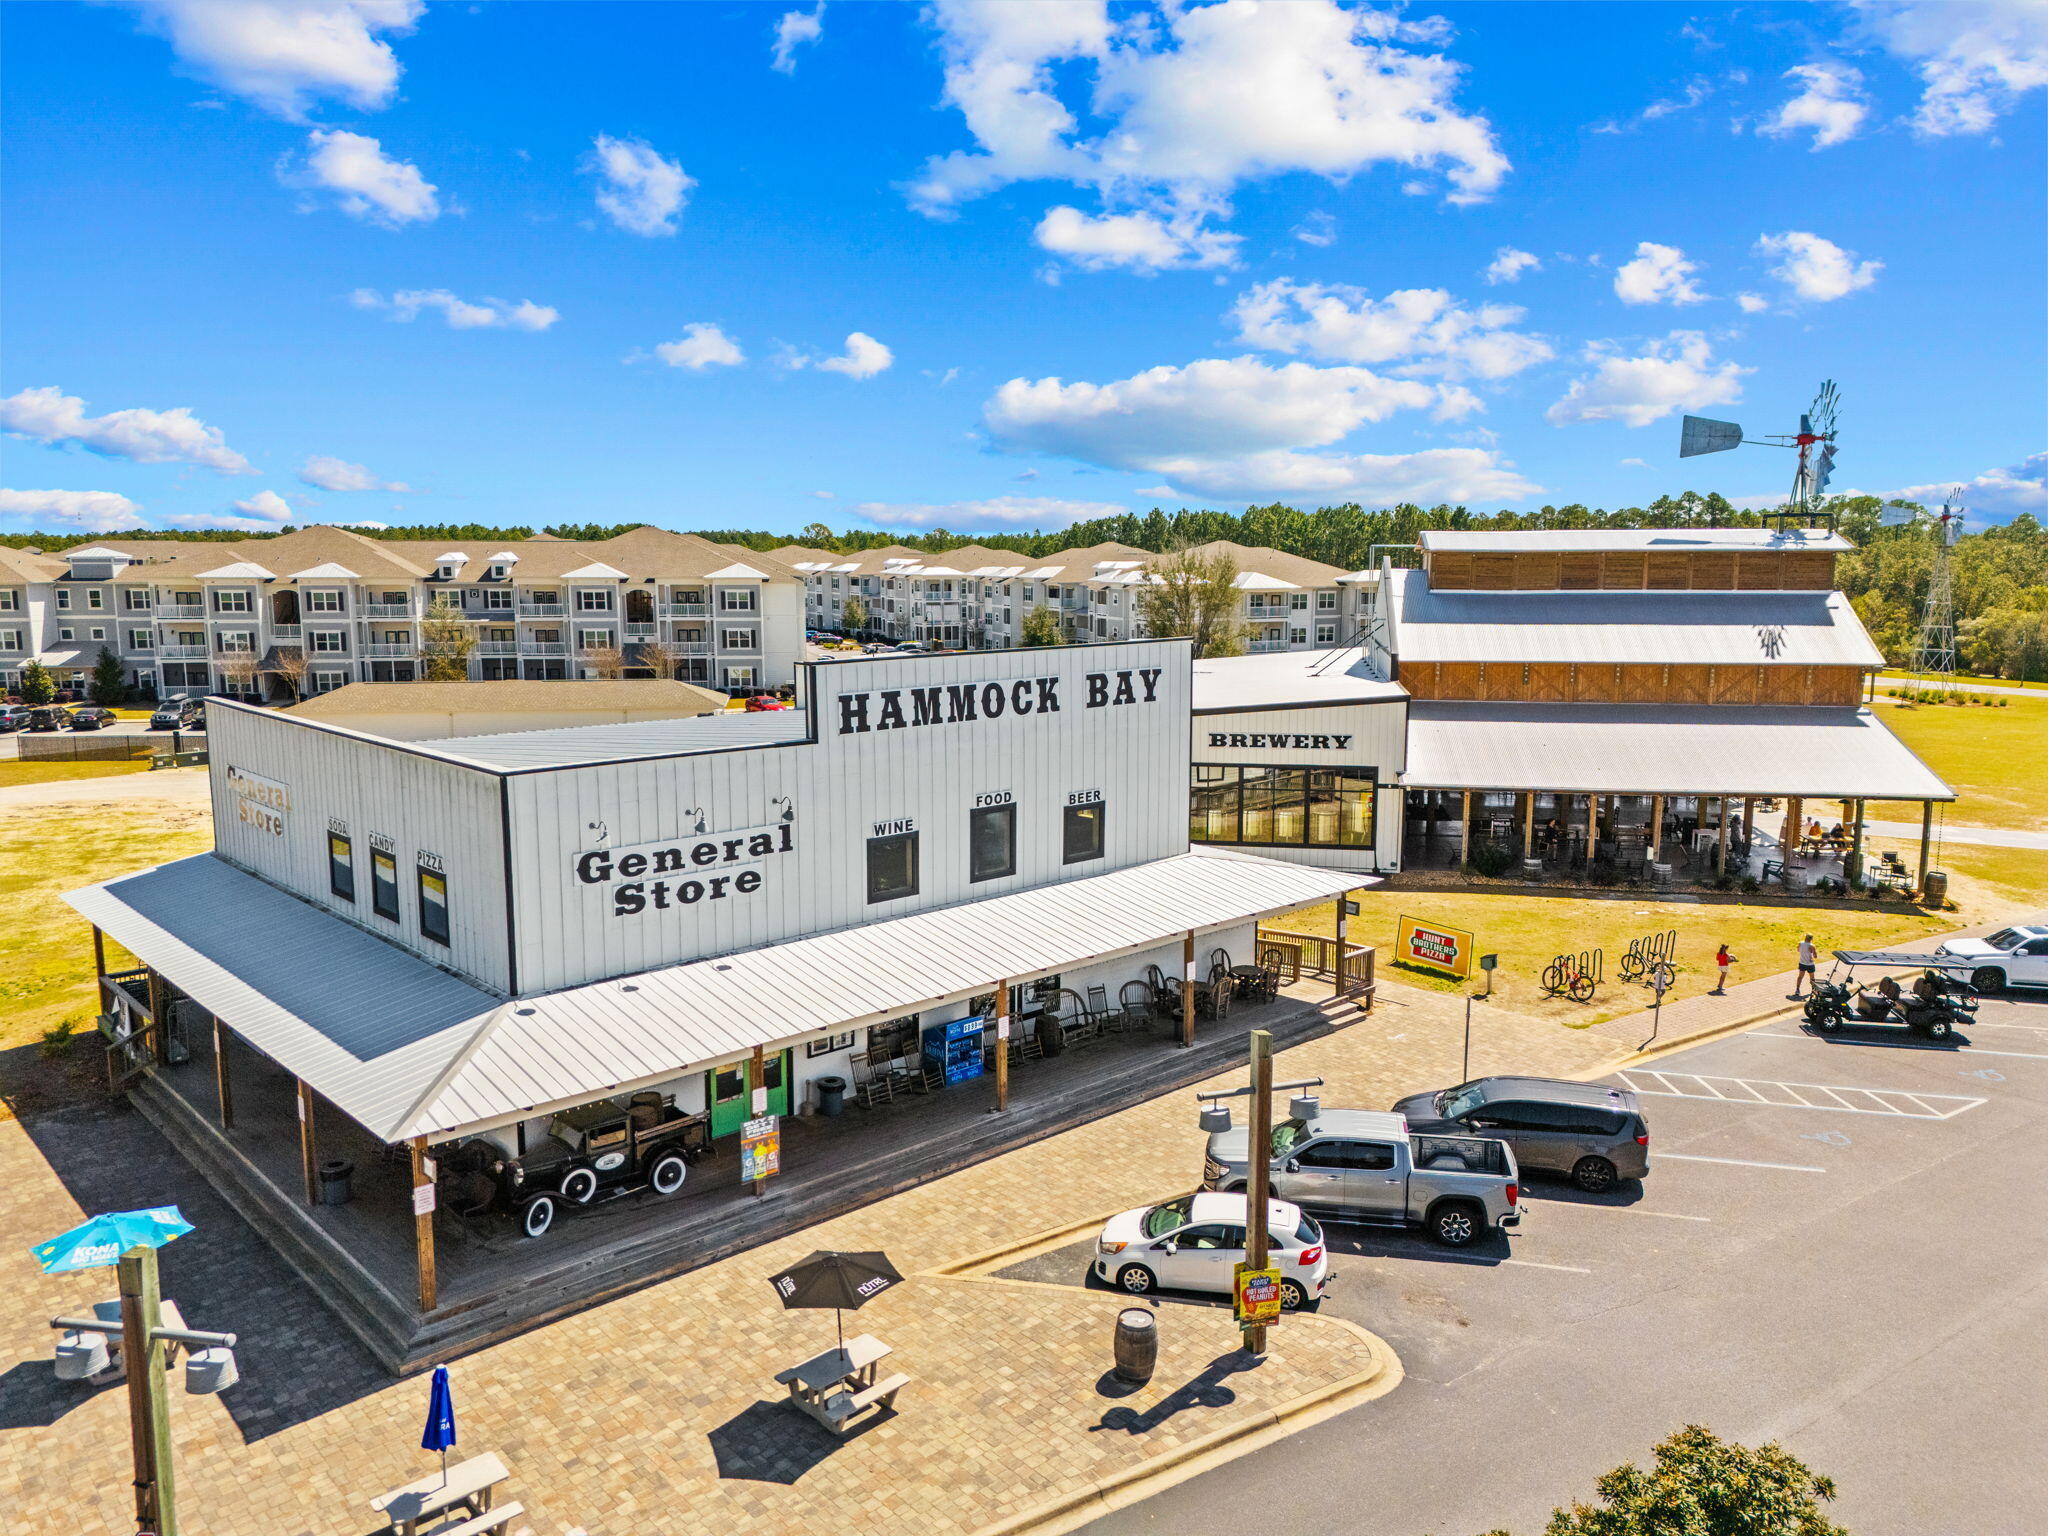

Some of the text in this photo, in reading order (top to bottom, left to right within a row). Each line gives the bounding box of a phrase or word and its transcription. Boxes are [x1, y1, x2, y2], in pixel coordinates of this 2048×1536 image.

[838, 668, 1162, 734] HAMMOCK BAY
[1208, 733, 1352, 749] BREWERY
[227, 765, 292, 811] General
[976, 791, 1012, 808] FOOD
[1069, 789, 1101, 806] BEER
[239, 797, 282, 836] Store
[328, 818, 348, 835] SODA
[873, 819, 914, 837] WINE
[369, 833, 395, 853] CANDY
[417, 850, 444, 871] PIZZA
[576, 823, 794, 884] General
[614, 870, 762, 917] Store
[1413, 938, 1455, 955] BROTHERS
[1422, 932, 1446, 945] HUNT
[1420, 947, 1445, 960] PIZZA
[72, 1243, 119, 1258] KONA
[1246, 1288, 1257, 1296] HOT
[1249, 1293, 1275, 1302] PEANUTS
